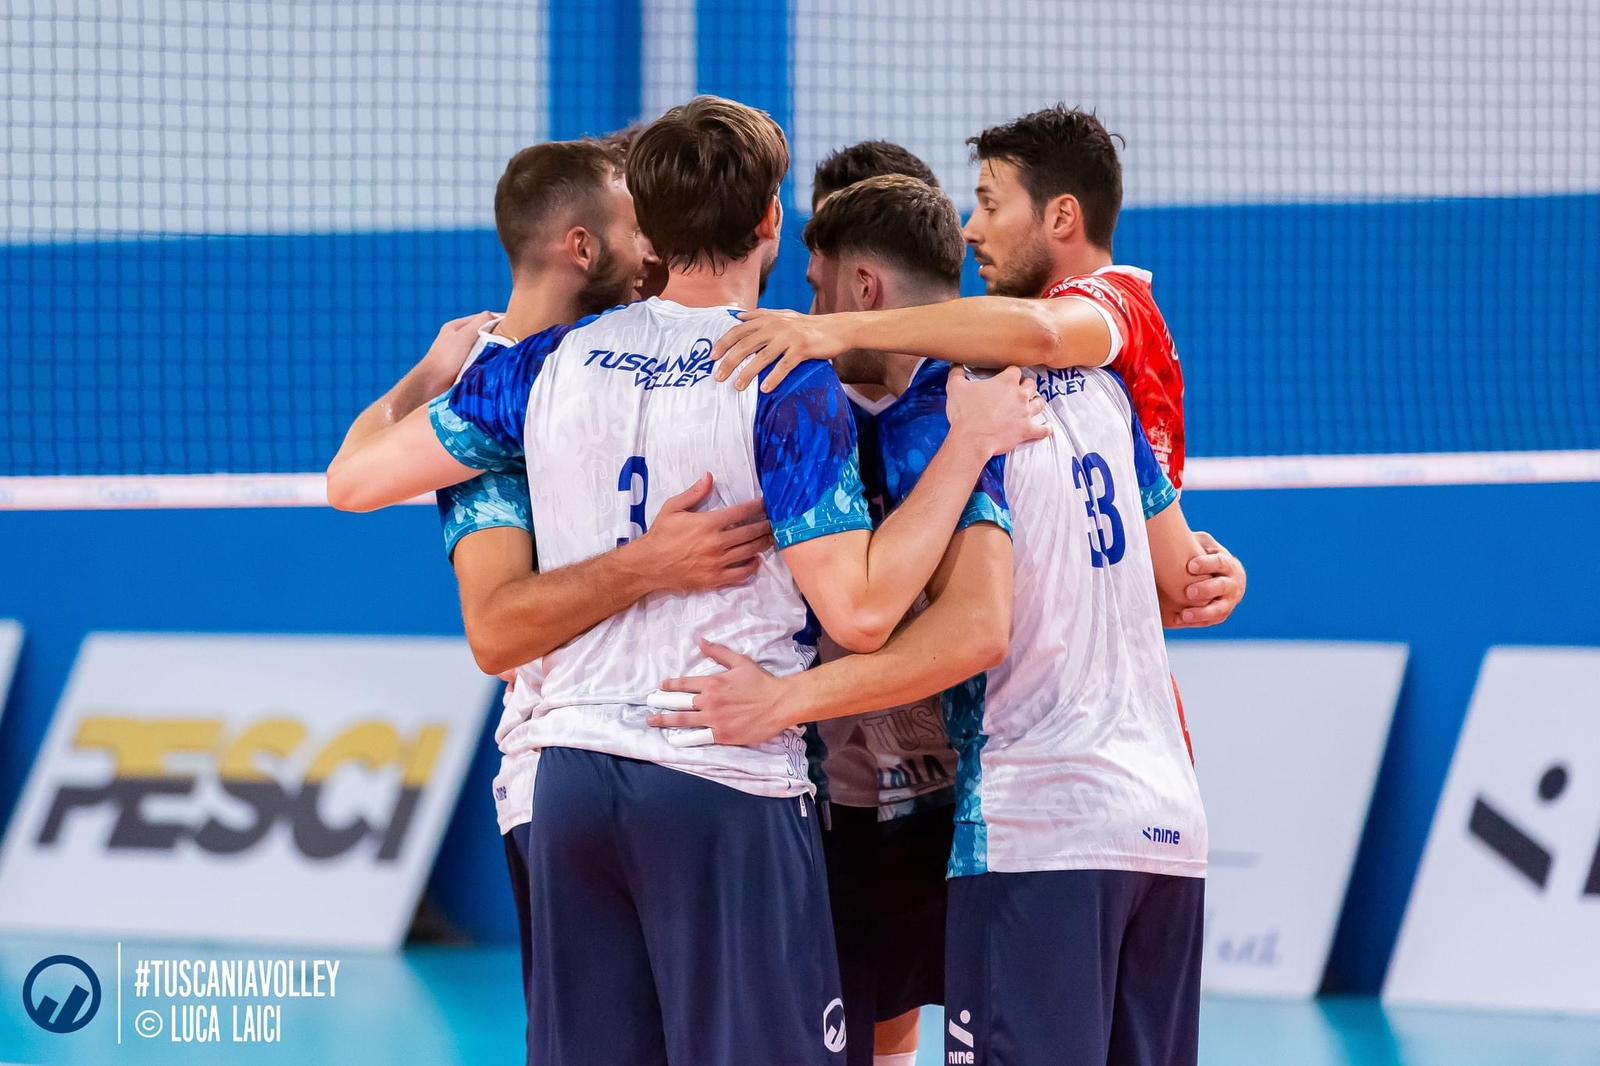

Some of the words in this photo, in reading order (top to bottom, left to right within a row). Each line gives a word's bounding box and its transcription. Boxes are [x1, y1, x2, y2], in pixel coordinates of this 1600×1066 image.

[583, 349, 717, 374] TUSCANIA
[634, 373, 711, 391] VOLLEY
[616, 456, 649, 549] 3
[1071, 452, 1126, 569] 33
[36, 716, 448, 862] PESCI
[1153, 827, 1181, 845] nine
[948, 1051, 975, 1065] nine
